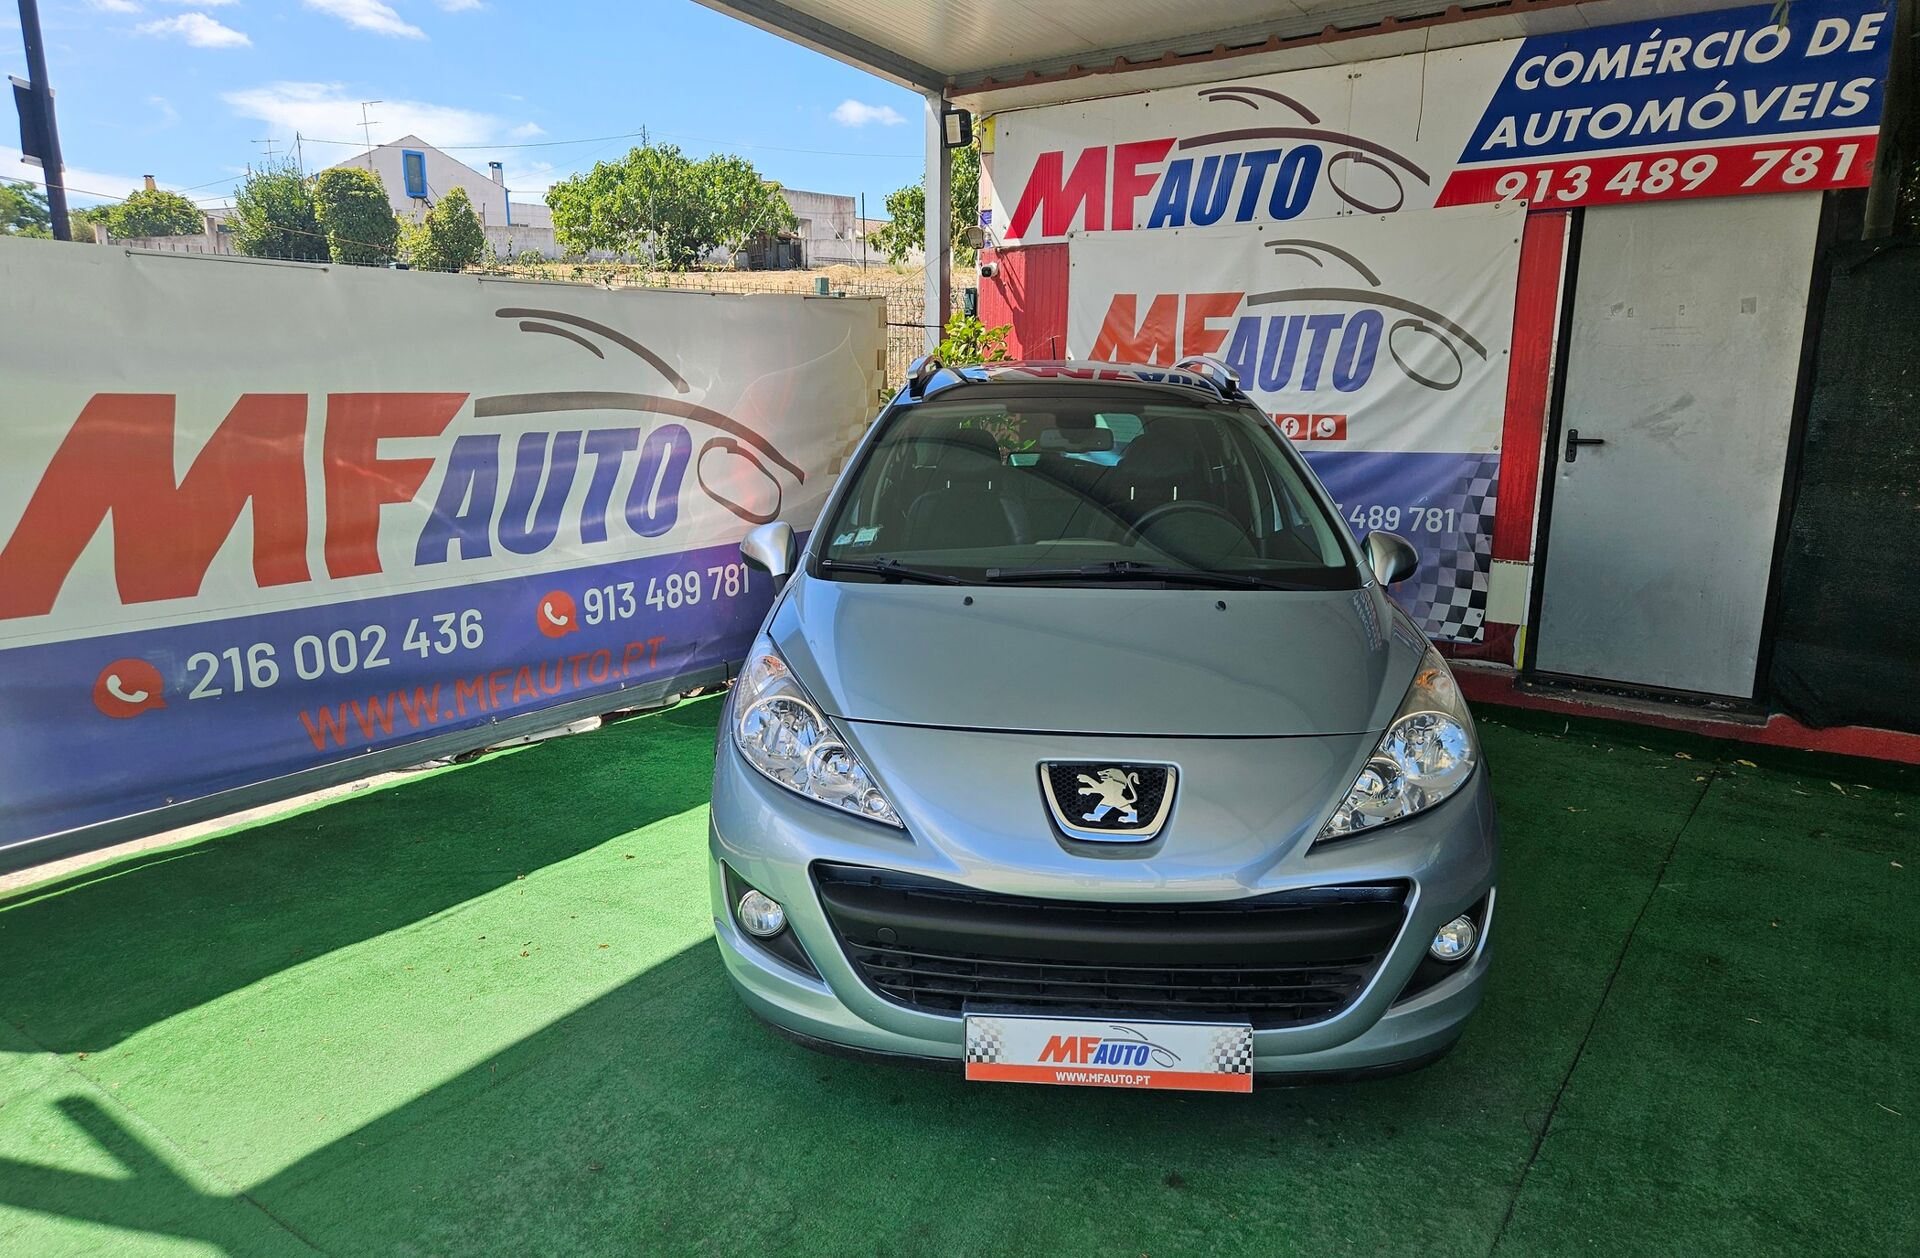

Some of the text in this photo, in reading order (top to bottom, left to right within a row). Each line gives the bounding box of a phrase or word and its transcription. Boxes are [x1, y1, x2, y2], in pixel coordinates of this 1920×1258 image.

[1515, 11, 1887, 91] COMÉRCIO DE
[1480, 79, 1878, 151] AUTOMÓVEIS
[1495, 144, 1860, 203] 913 489 781
[1350, 504, 1455, 533] 489 781
[583, 563, 750, 625] 913 489 781
[186, 608, 484, 700] 216 002 436
[299, 635, 668, 751] WWW.MFAUTO.PT
[1055, 1070, 1152, 1086] WWW.MFAUTO.PT
